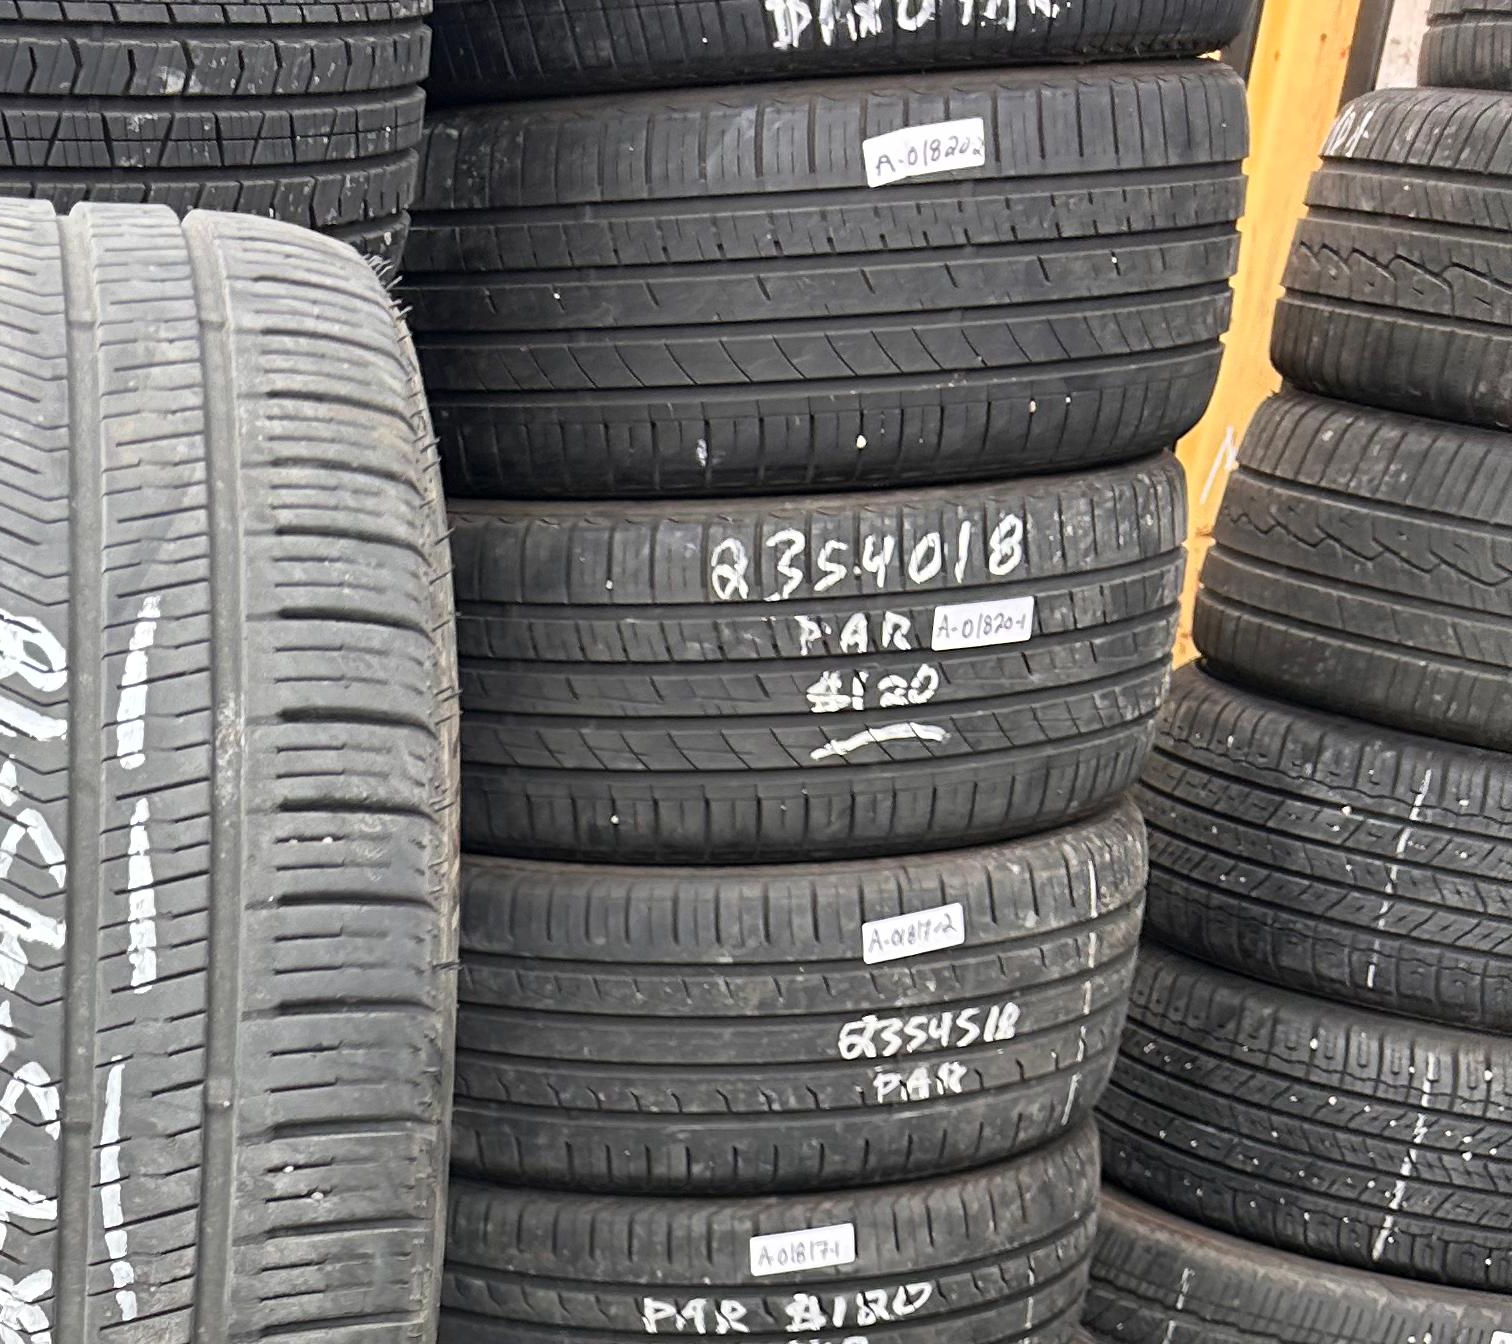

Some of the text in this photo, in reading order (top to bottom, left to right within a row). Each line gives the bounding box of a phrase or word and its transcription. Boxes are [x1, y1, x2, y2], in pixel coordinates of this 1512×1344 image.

[794, 611, 912, 656] PAR
[872, 1061, 968, 1104] PAR
[641, 1296, 751, 1334] PAR
